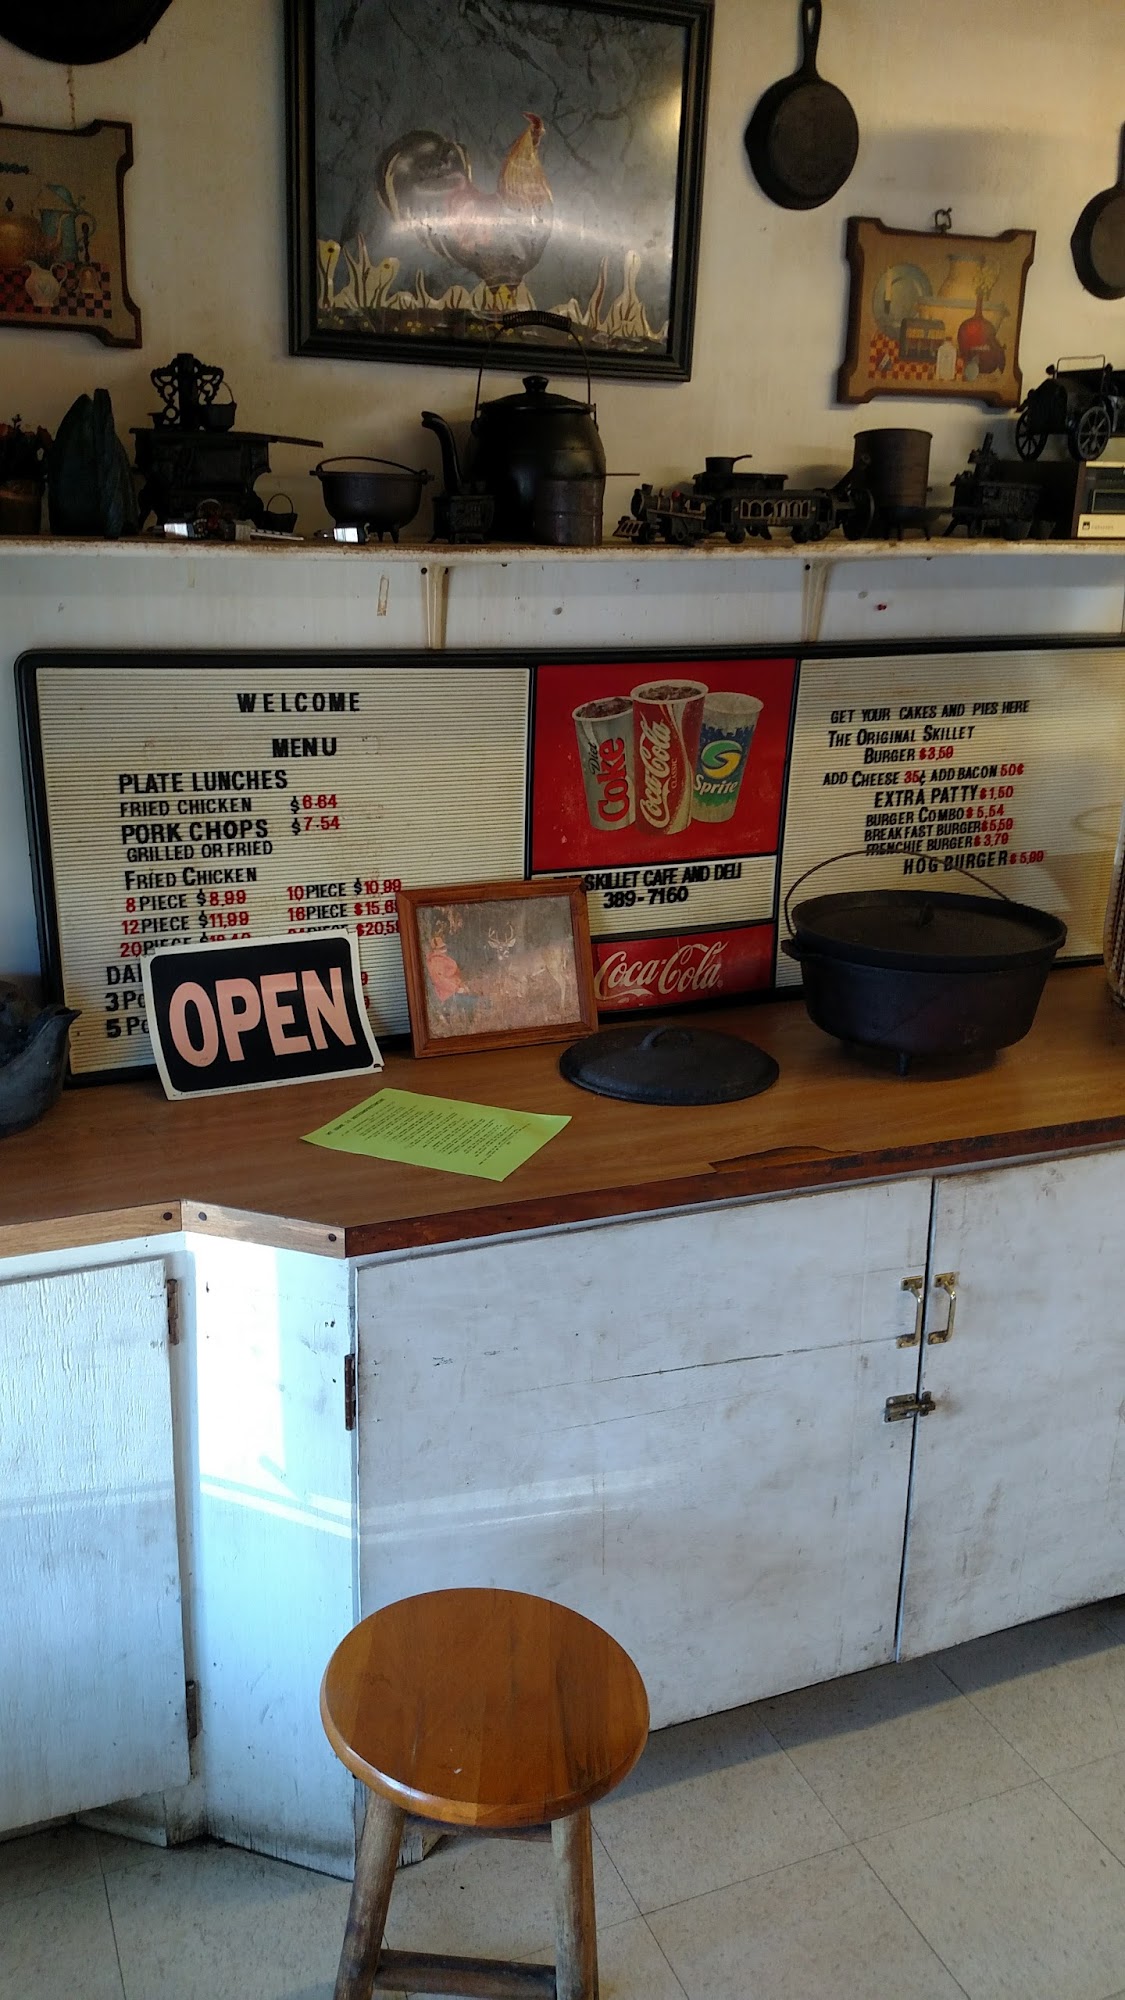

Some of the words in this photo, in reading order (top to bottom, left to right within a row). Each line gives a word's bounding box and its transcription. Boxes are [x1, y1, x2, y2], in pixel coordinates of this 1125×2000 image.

[237, 692, 360, 712] WELCOME
[831, 709, 856, 724] GET
[862, 707, 891, 722] YOUR
[899, 705, 937, 720] CAKES
[941, 703, 966, 718] AND
[972, 701, 999, 716] PIES
[1001, 700, 1030, 715] HERE
[272, 737, 337, 757] MENU
[828, 730, 852, 748] THE
[856, 727, 917, 746] ORIGINAL
[923, 724, 976, 742] SKILLET
[587, 741, 598, 776] Diet
[863, 747, 916, 765] BURGER
[119, 772, 184, 794] PLATE
[192, 770, 287, 792] LUNCHES
[597, 737, 630, 823] Coke
[694, 773, 738, 796] Sprite
[823, 771, 848, 786] ADD
[851, 770, 900, 788] CHEESE
[930, 767, 955, 782] ADD
[957, 765, 998, 780] BACON
[120, 800, 170, 817] FRIED
[177, 797, 252, 815] CHICKEN
[874, 788, 926, 808] EXTRA
[931, 785, 979, 804] PATTY
[866, 810, 914, 827] BURGER
[918, 806, 965, 824] COMBO
[121, 822, 183, 845] PORK
[189, 819, 268, 842] CHOPS
[936, 820, 981, 838] BURGER
[127, 844, 194, 862] GRILLED
[201, 843, 223, 858] OR
[227, 840, 273, 857] FRIED
[926, 835, 973, 851] BURGER
[903, 855, 939, 875] HOG
[944, 850, 1008, 872] BURGER
[124, 870, 176, 891] FRIED
[182, 867, 257, 887] CHICKEN
[584, 870, 641, 892] SKILLET
[643, 868, 680, 887] CAFE
[682, 865, 710, 883] AND
[714, 862, 742, 881] DELI
[603, 886, 689, 908] 389-7160
[594, 941, 729, 1000] Coca-Cola
[169, 967, 357, 1068] OPEN
